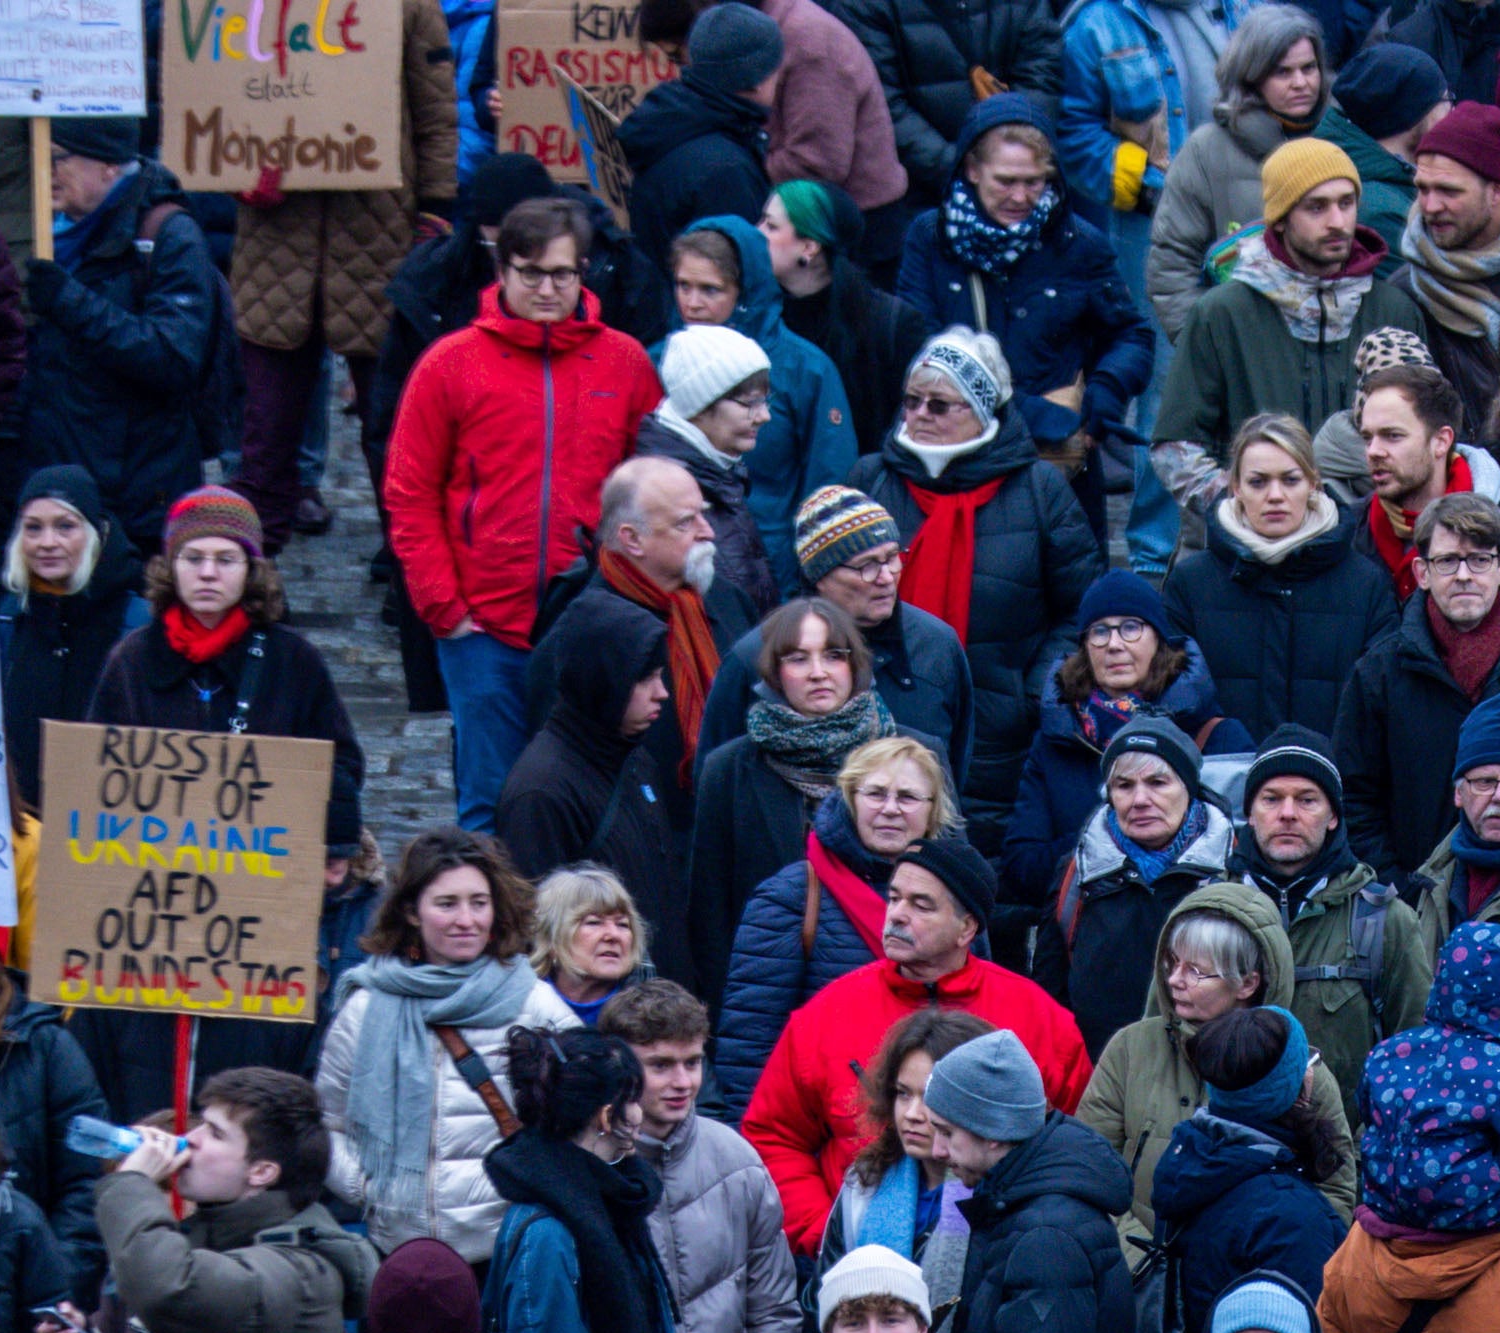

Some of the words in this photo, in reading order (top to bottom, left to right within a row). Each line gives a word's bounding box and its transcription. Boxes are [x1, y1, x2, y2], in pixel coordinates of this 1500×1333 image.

[180, 0, 367, 78] Vielfalt
[49, 58, 135, 76] MENSCHEN
[506, 46, 680, 88] RASSISMU
[184, 106, 382, 177] Monotonie
[101, 768, 199, 817] OUT
[216, 779, 273, 823] OF
[126, 870, 218, 915] AFD
[96, 908, 187, 952] OUT
[205, 914, 262, 960] OF
[58, 948, 306, 1015] BUNDESTAG
